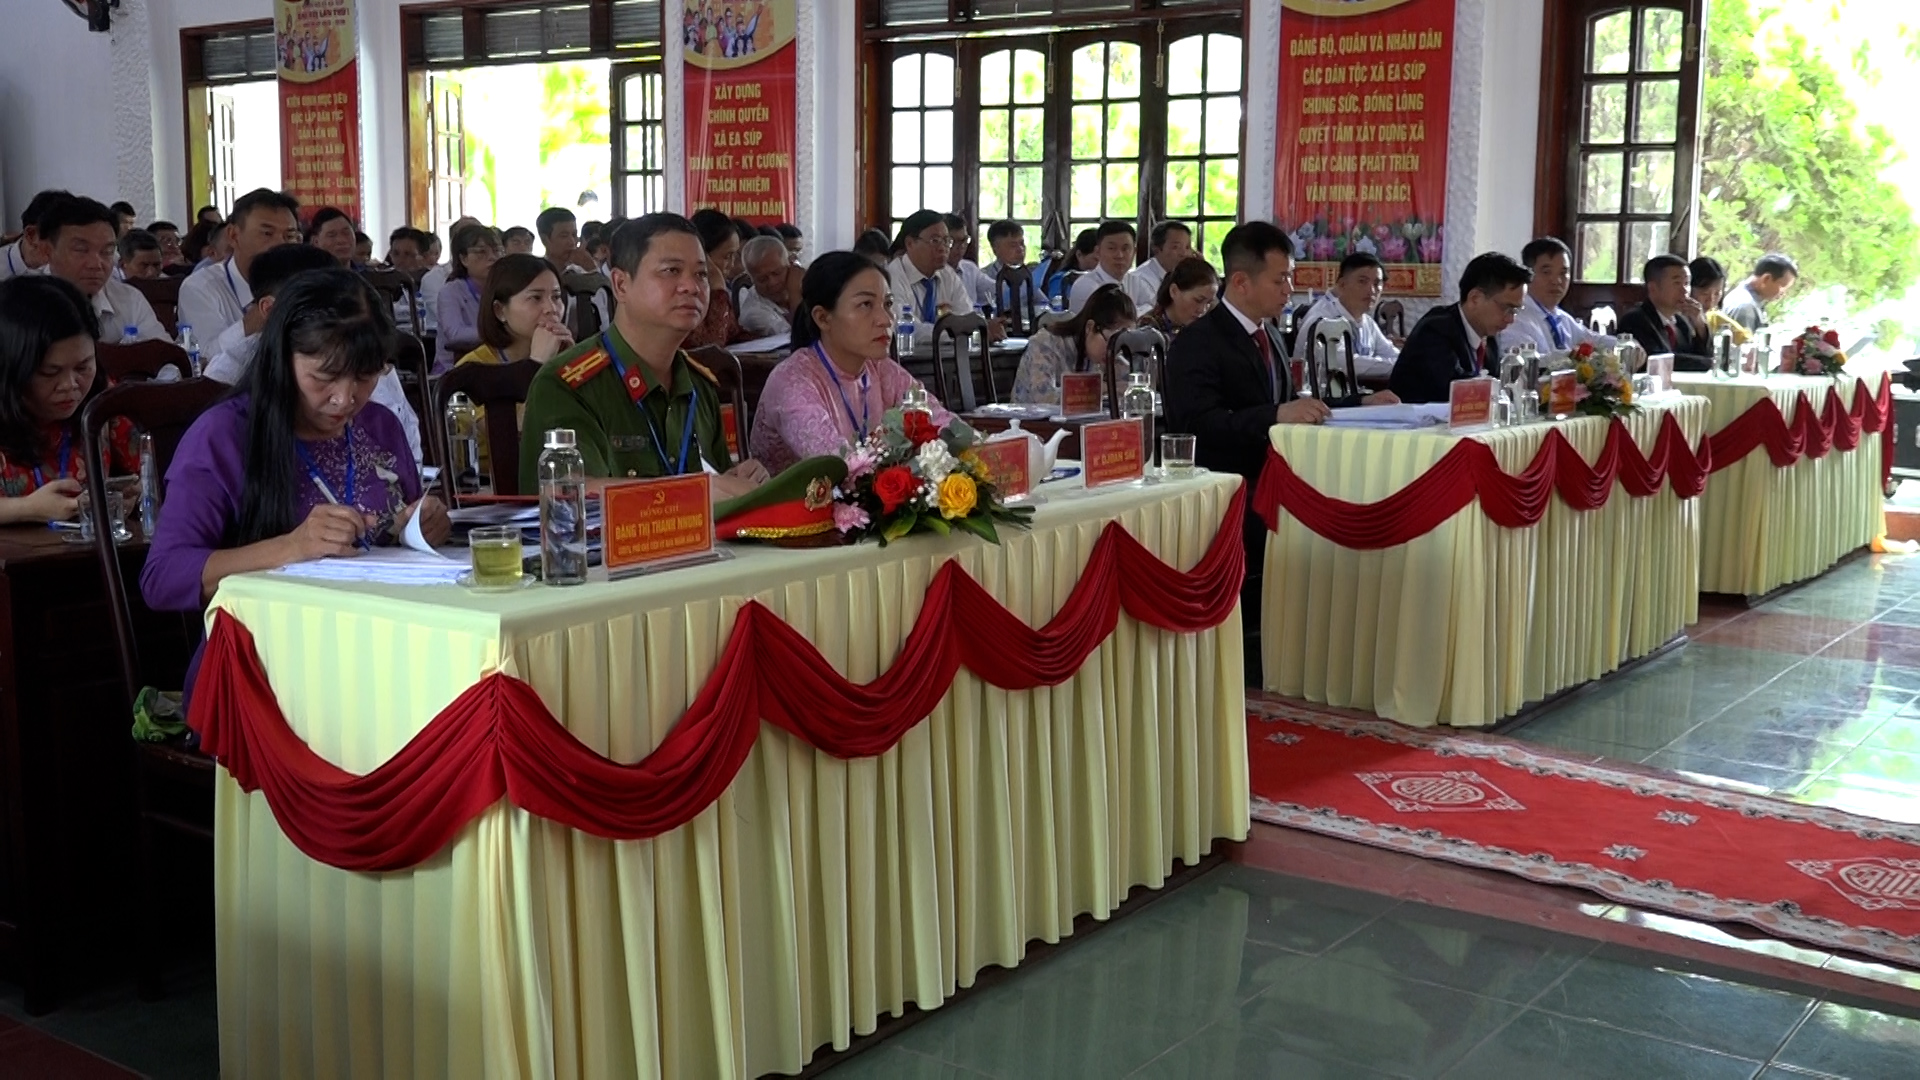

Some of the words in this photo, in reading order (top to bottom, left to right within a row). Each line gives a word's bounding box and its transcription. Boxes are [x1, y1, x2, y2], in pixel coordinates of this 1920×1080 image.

[1338, 31, 1368, 56] QUÂN
[1370, 29, 1384, 53] VÀ
[1386, 29, 1417, 51] NHÂN
[1418, 27, 1443, 50] DÂN
[1302, 64, 1323, 86] CÁC
[1324, 63, 1346, 84] DÂN
[1348, 61, 1368, 88] TỘC
[1370, 61, 1385, 82] XÃ
[1387, 63, 1401, 82] EA
[1403, 59, 1427, 82] SÚP
[714, 84, 733, 101] XÂY
[735, 82, 761, 103] DỰNG
[1302, 97, 1336, 114] CHUNG
[1396, 89, 1424, 111] LÒNG
[707, 107, 736, 124] CHÍNH
[714, 131, 727, 147] XÃ
[729, 132, 741, 146] EA
[743, 129, 763, 146] SÚP
[1299, 122, 1330, 146] QUYẾT
[1332, 122, 1353, 142] TÂM
[1356, 121, 1377, 142] XÂY
[1378, 121, 1407, 146] DỰNG
[1409, 120, 1425, 142] XÃ
[716, 150, 733, 170] KẾT
[741, 149, 755, 170] KỶ
[1360, 151, 1387, 172] PHÁT
[1389, 147, 1420, 173] TRIỂN
[706, 175, 737, 193] TRÁCH
[739, 174, 771, 195] NHIỆM
[1306, 182, 1327, 202] VĂN
[1360, 180, 1383, 202] BẢN
[1385, 177, 1411, 202] SẮC!
[733, 197, 760, 216] NHÂN
[651, 517, 677, 535] THANH
